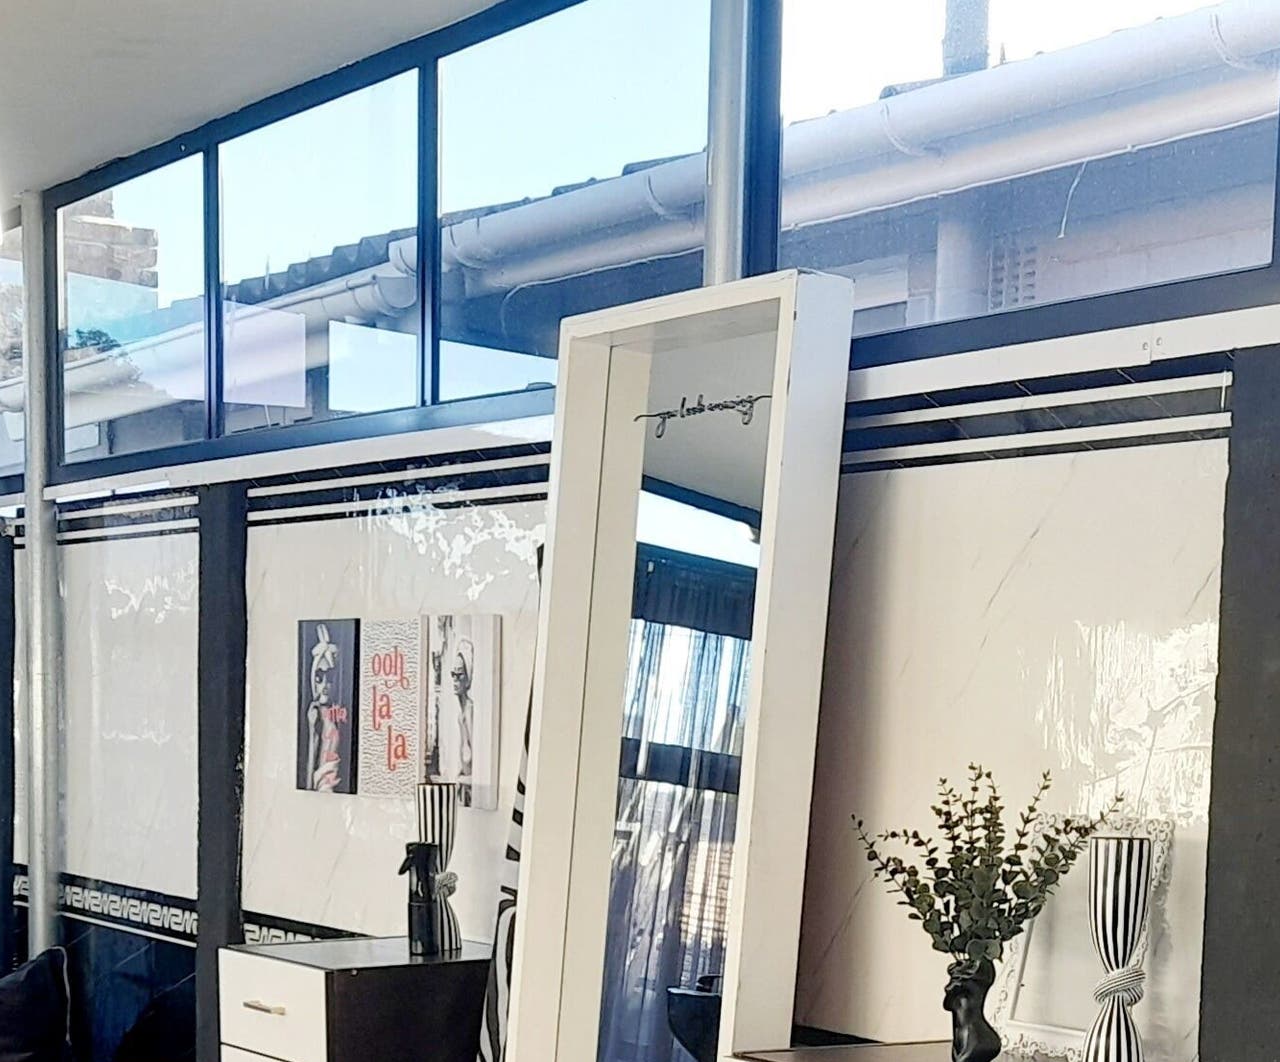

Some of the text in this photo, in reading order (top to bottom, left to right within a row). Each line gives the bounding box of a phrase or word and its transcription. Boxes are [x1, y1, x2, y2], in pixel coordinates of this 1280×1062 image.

[372, 646, 410, 690] ooh
[372, 685, 392, 731] la
[387, 725, 408, 772] la
